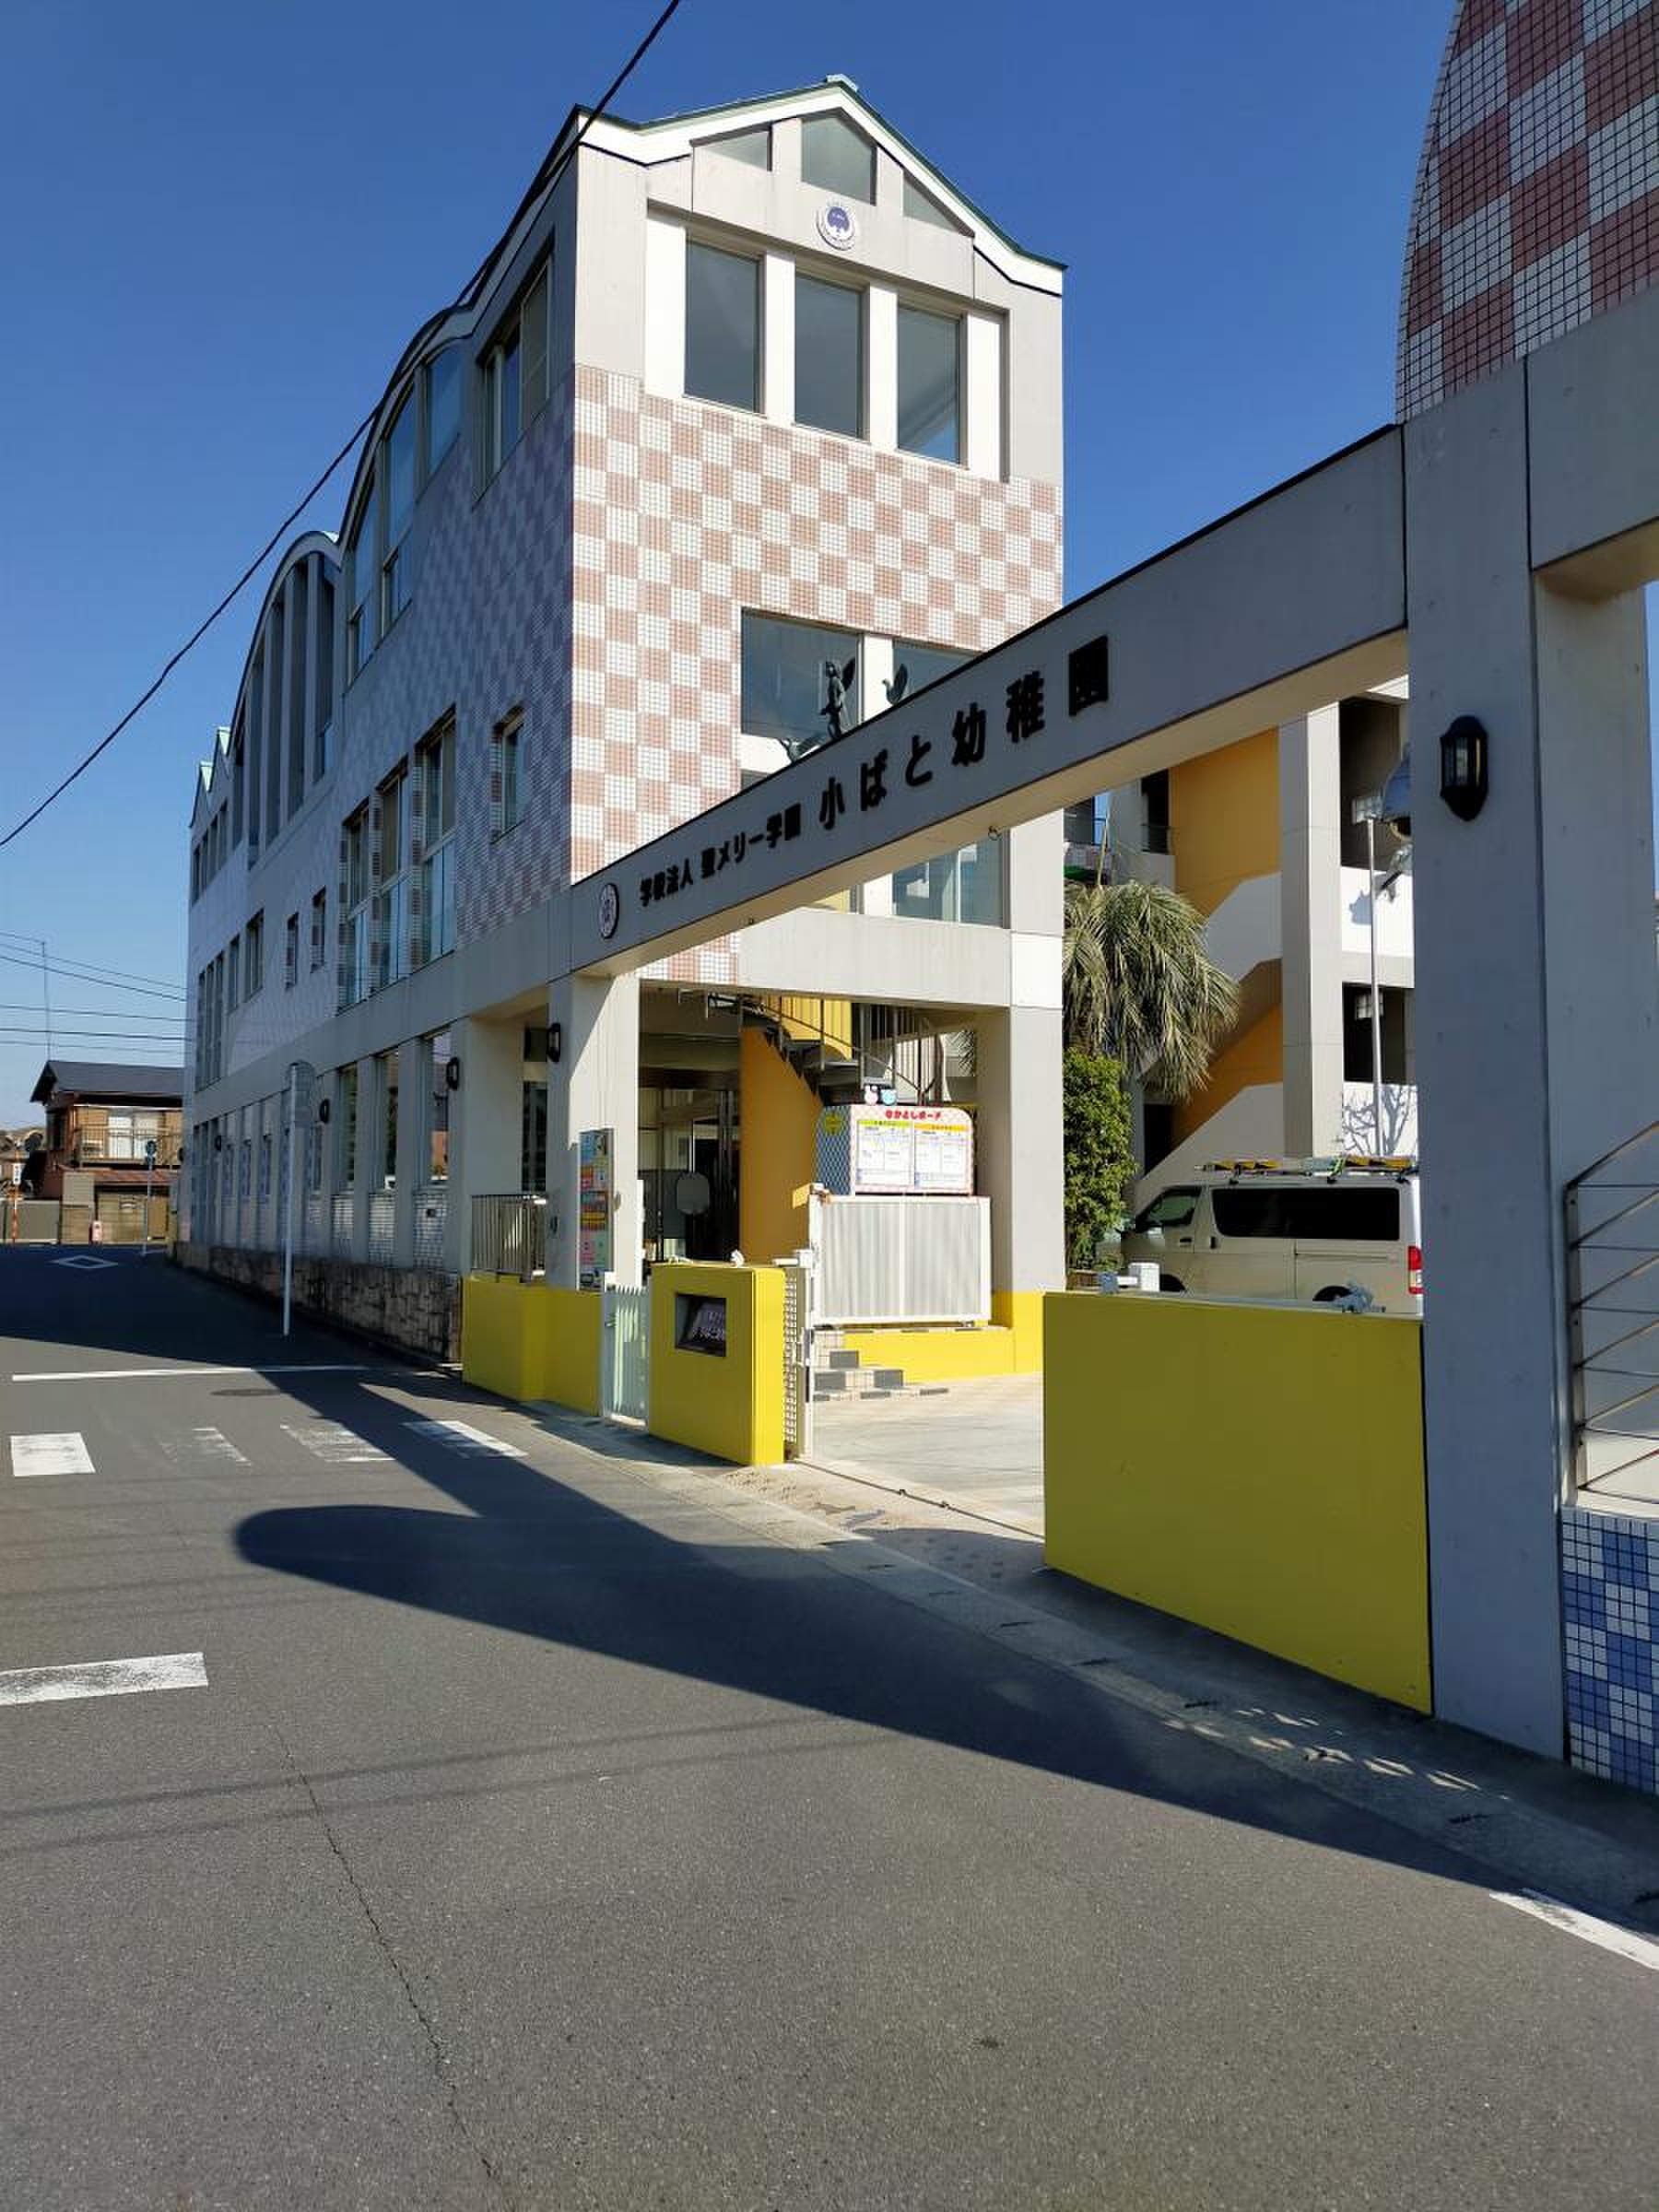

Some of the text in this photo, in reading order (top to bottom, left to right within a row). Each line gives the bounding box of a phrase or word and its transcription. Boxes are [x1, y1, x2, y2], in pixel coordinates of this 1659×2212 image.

[640, 634, 1109, 908] 学校法人 聖メリー学園 小ばと幼稚園
